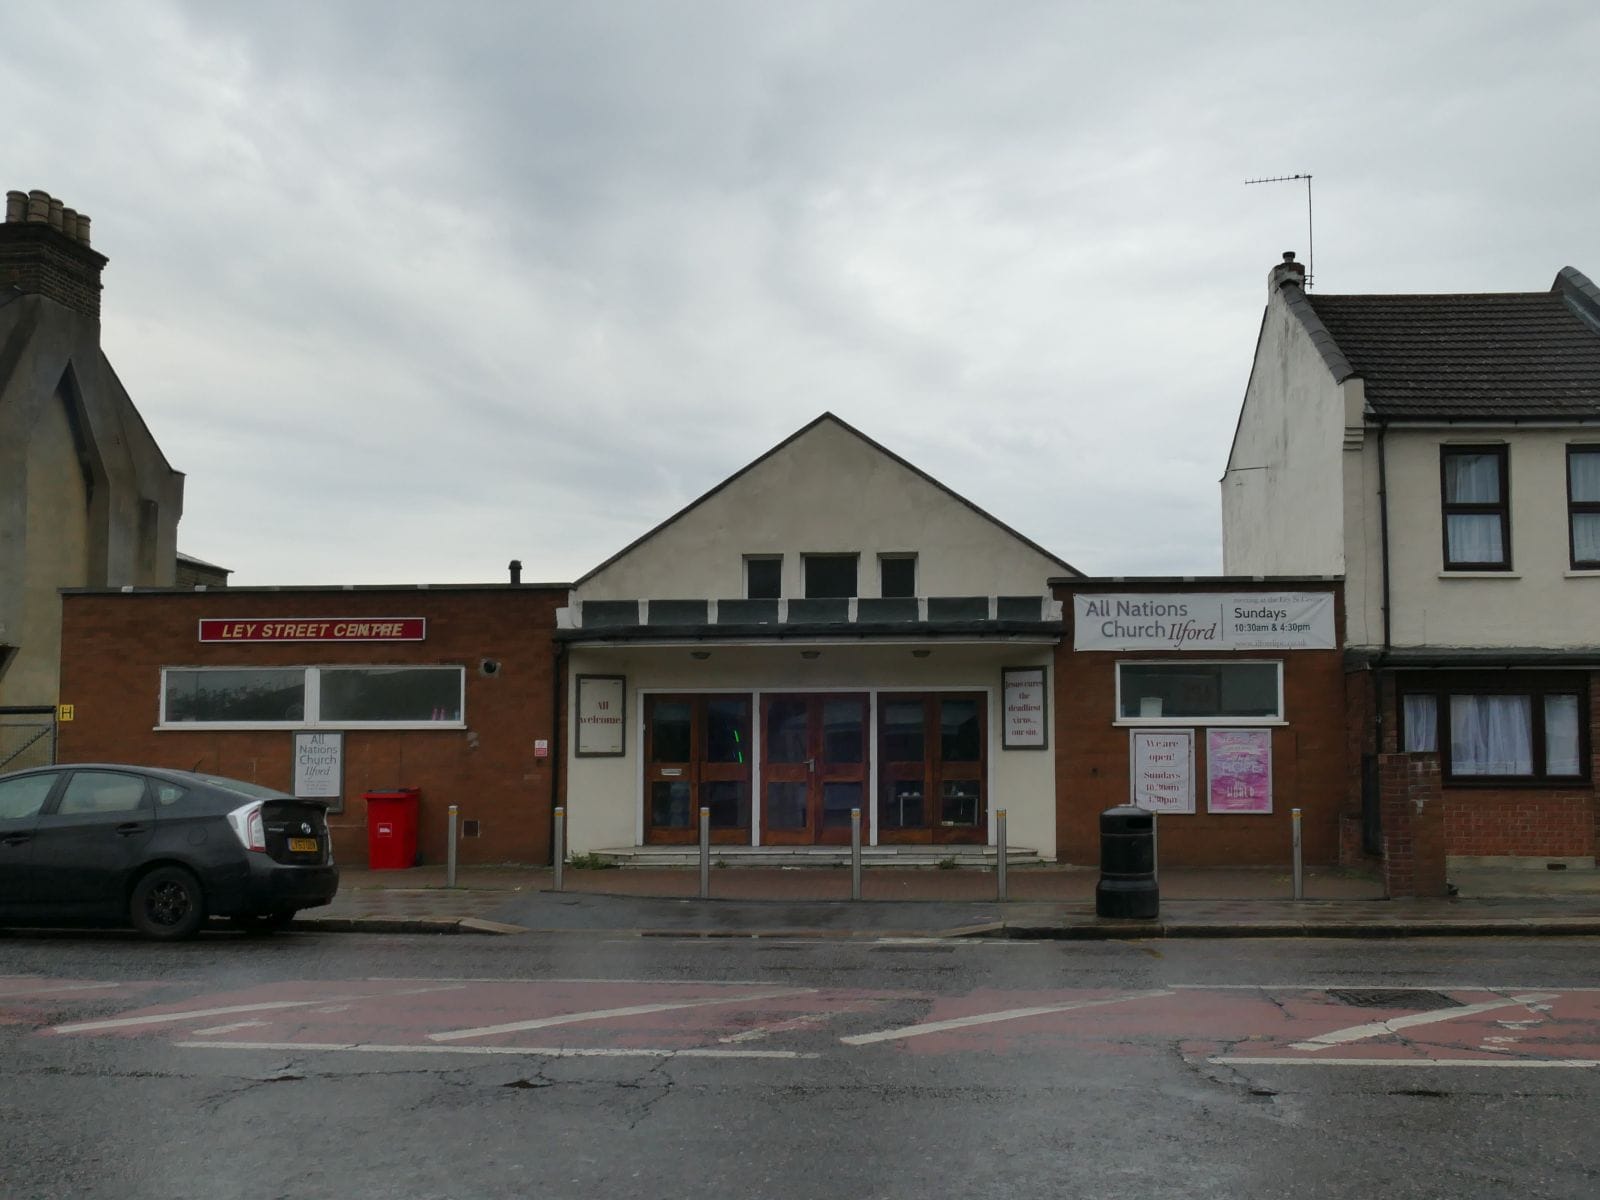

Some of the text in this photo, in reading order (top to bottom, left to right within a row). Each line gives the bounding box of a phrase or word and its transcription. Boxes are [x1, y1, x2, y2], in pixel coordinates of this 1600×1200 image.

[1085, 599, 1188, 617] All Nations
[1234, 607, 1287, 621] Sundays
[222, 624, 256, 638] LEY
[262, 624, 330, 638] STREET
[1234, 623, 1311, 633] 10:30am & 4:30pm
[1101, 619, 1217, 648] Church Ilford
[1018, 692, 1031, 700] the
[598, 701, 609, 710] All
[1008, 704, 1041, 712] deadliest
[311, 733, 325, 745] All
[1146, 739, 1161, 748] We
[300, 745, 338, 754] Nations
[300, 754, 337, 765] Church
[1149, 753, 1176, 763] open!
[1144, 771, 1181, 780] Sundays
